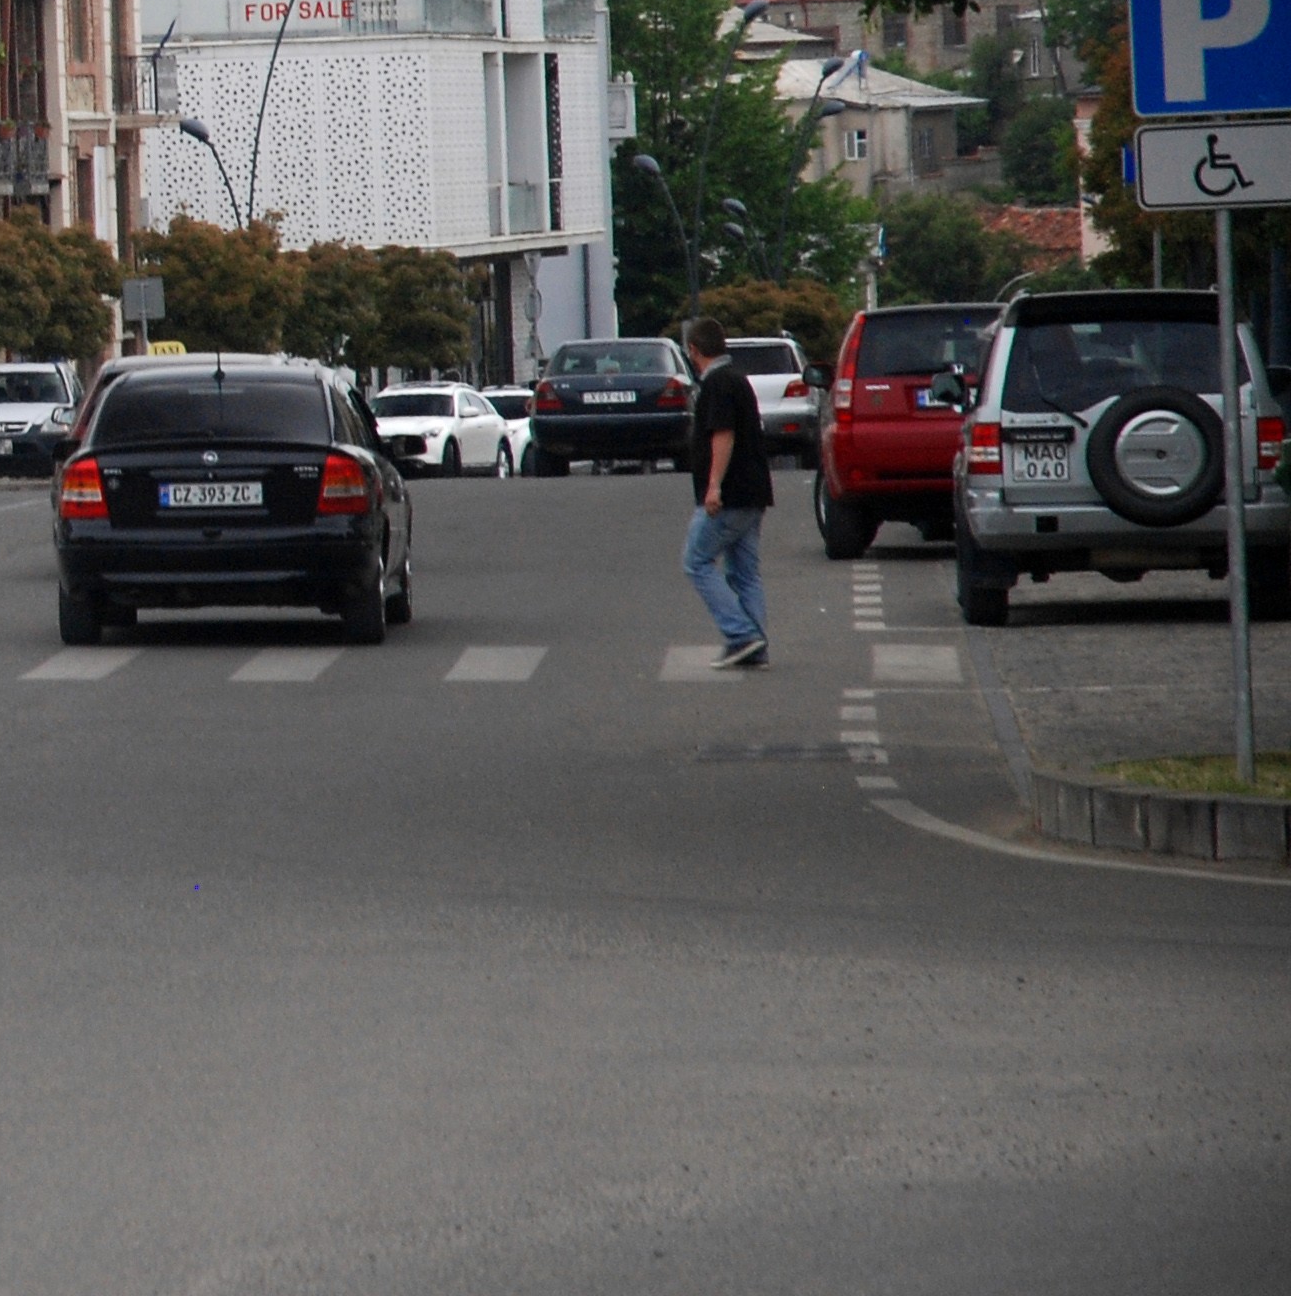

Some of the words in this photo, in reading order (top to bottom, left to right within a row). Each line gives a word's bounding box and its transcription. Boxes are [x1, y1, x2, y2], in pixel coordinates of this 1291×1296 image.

[245, 2, 289, 22] FOR
[299, 0, 355, 20] SALE
[1027, 462, 1065, 478] 040
